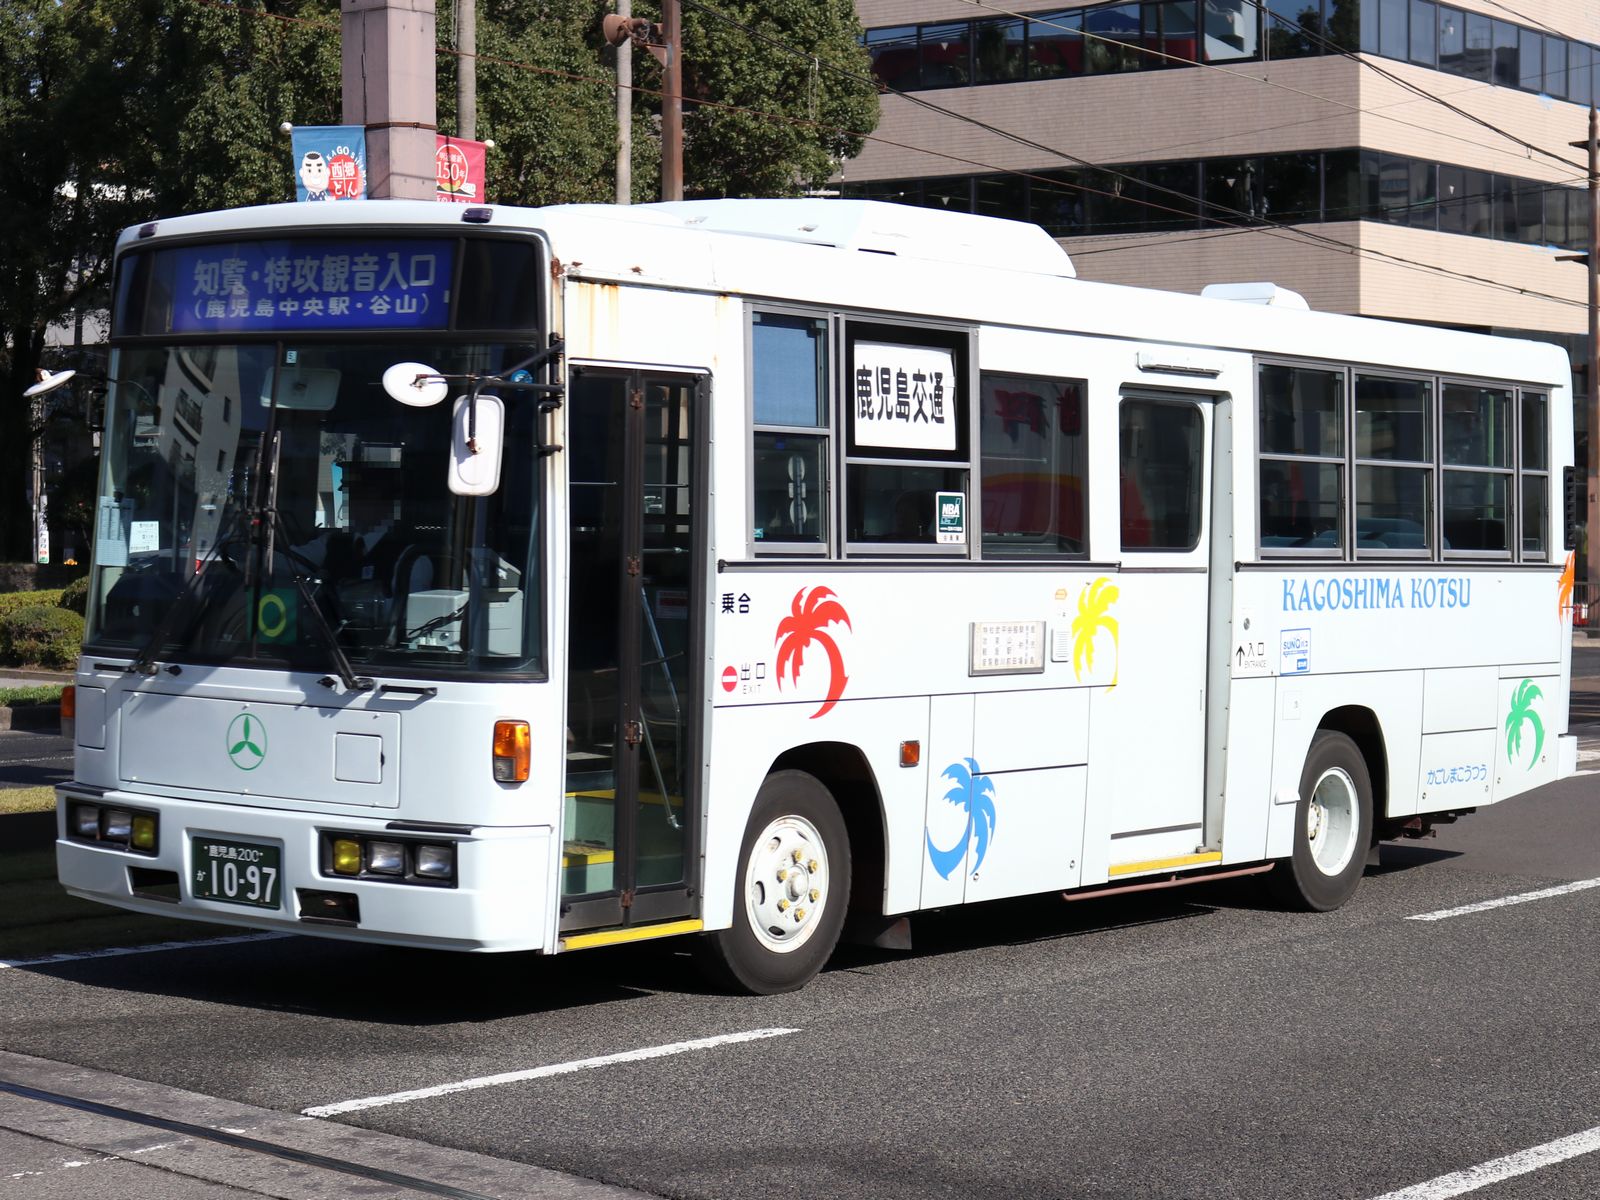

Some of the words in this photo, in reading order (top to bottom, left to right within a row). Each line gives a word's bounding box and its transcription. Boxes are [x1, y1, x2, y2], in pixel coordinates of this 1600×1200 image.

[192, 253, 437, 296] 知覧・特攻観音入口
[855, 364, 946, 425] 鹿児島交通
[942, 503, 960, 516] NBA
[722, 592, 751, 614] 乗合
[1282, 578, 1404, 612] KAGOSHIMA
[1411, 577, 1471, 609] KOTSU
[1247, 642, 1265, 657] 入口
[740, 662, 766, 681] 出口
[211, 860, 277, 903] 10-97
